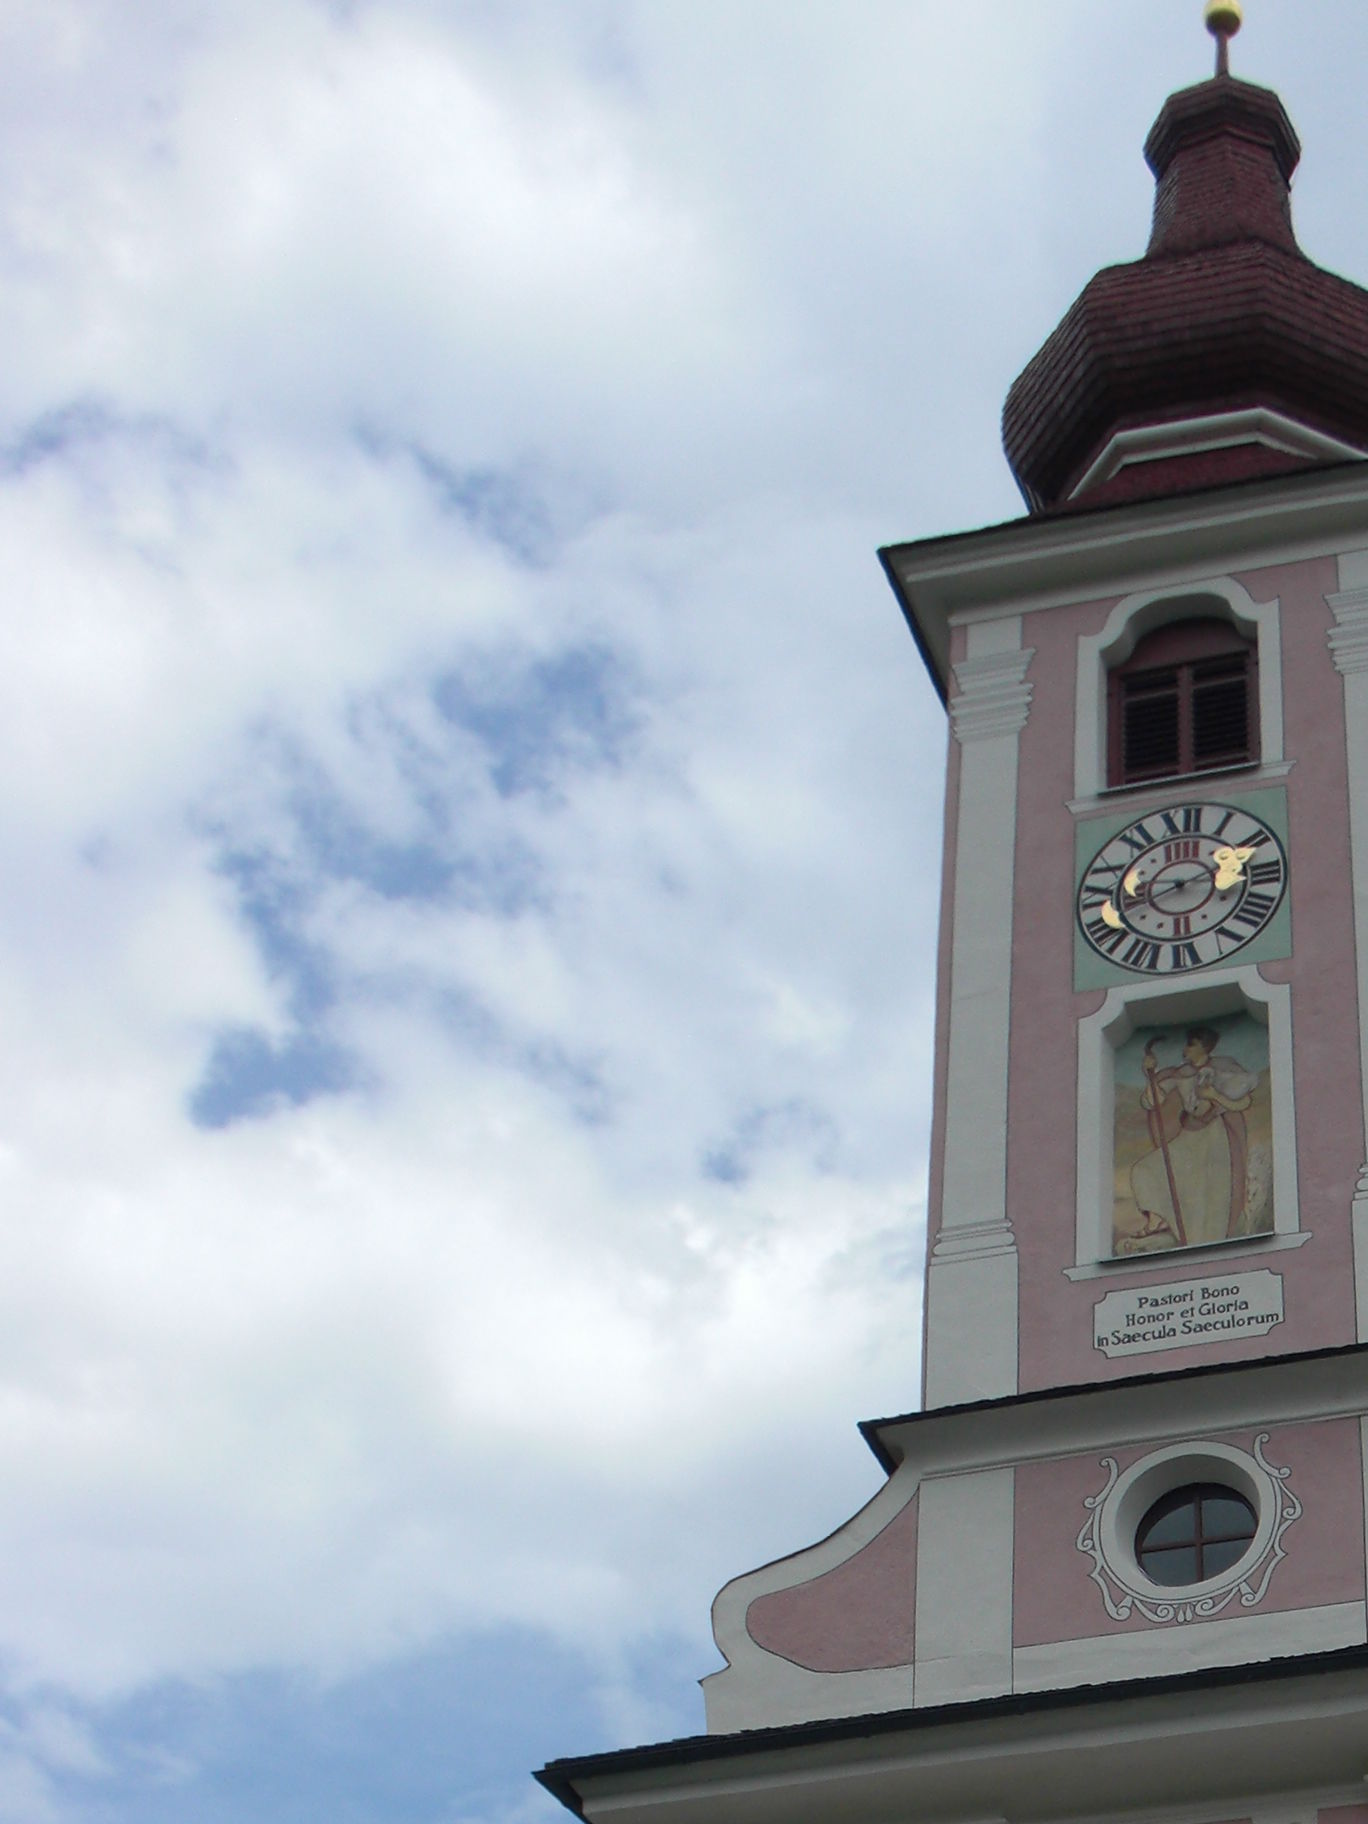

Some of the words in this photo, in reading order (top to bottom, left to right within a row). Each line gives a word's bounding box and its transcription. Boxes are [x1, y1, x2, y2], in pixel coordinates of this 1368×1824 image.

[1137, 1290, 1194, 1309] Pastori
[1201, 1284, 1240, 1300] Bono
[1126, 1312, 1174, 1327] Honor
[1180, 1303, 1196, 1319] et
[1199, 1299, 1249, 1316] Gloria
[1112, 1325, 1176, 1346] Saecula
[1181, 1312, 1280, 1335] Saeculorum
